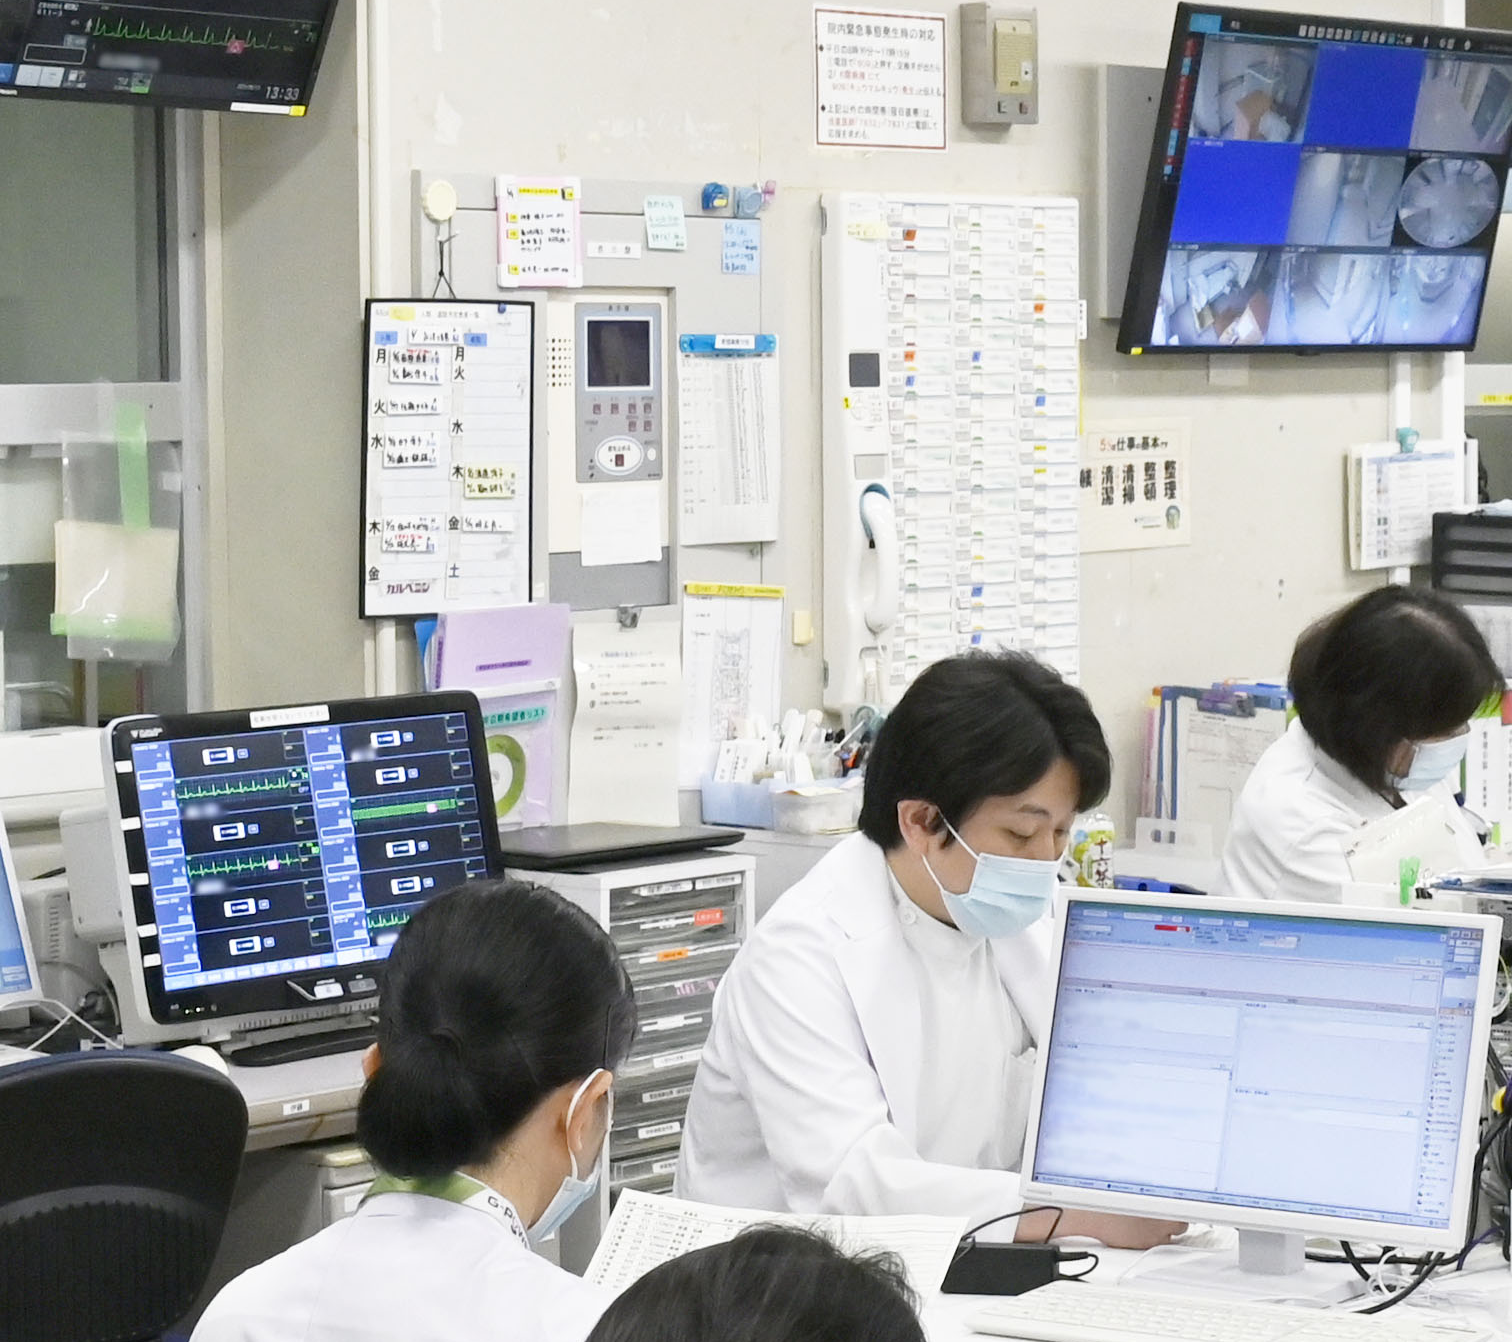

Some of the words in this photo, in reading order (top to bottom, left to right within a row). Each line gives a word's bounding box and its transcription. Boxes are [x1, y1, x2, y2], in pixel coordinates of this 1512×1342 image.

[265, 86, 300, 101] 13:33
[376, 348, 386, 364] 月
[454, 347, 465, 362] 月
[454, 365, 465, 380] 火
[374, 399, 386, 414] 火
[451, 419, 463, 434] 水
[371, 434, 383, 449] 水
[451, 465, 464, 479] 木
[368, 519, 381, 534] 木
[448, 515, 460, 530] 金
[368, 566, 380, 581] 金
[448, 563, 460, 578] 土
